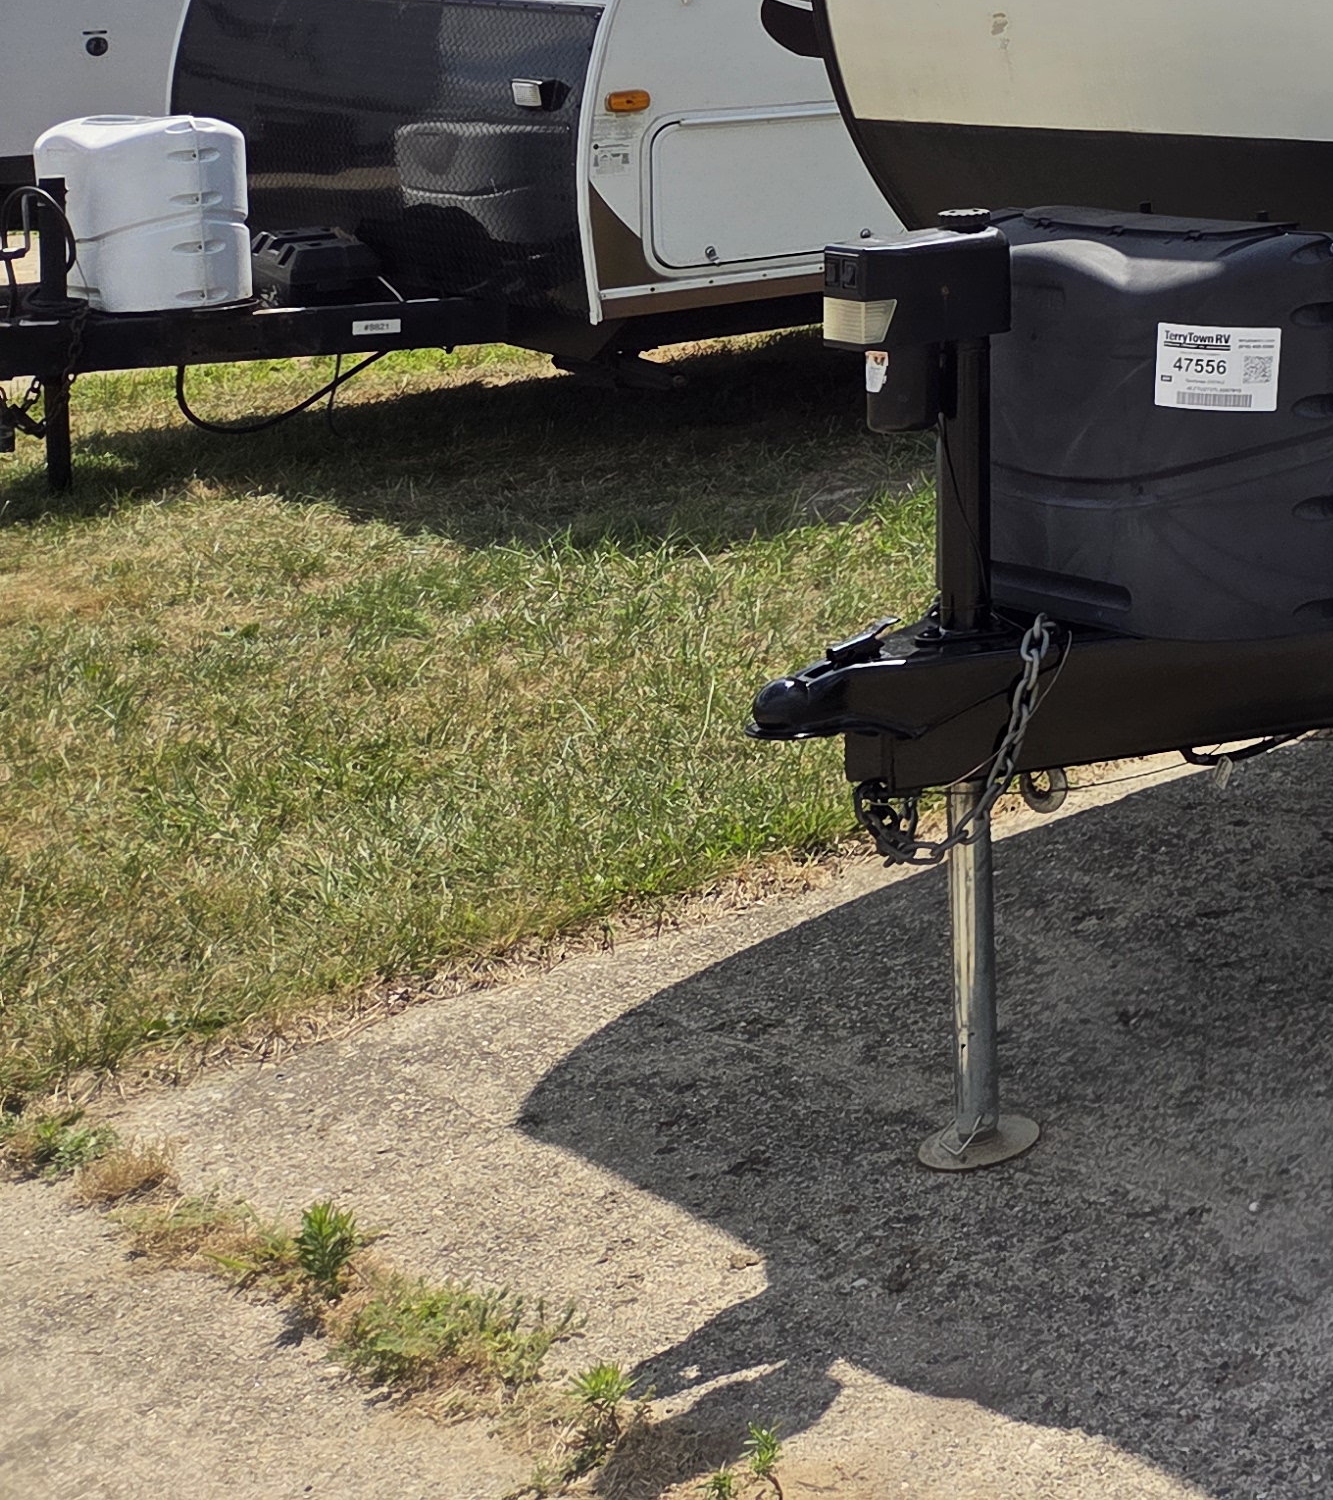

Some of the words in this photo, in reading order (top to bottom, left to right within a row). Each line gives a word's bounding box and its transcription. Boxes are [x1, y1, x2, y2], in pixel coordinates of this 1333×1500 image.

[1164, 330, 1214, 344] TerryTown
[1215, 333, 1231, 344] RV
[1173, 357, 1227, 375] 47556
